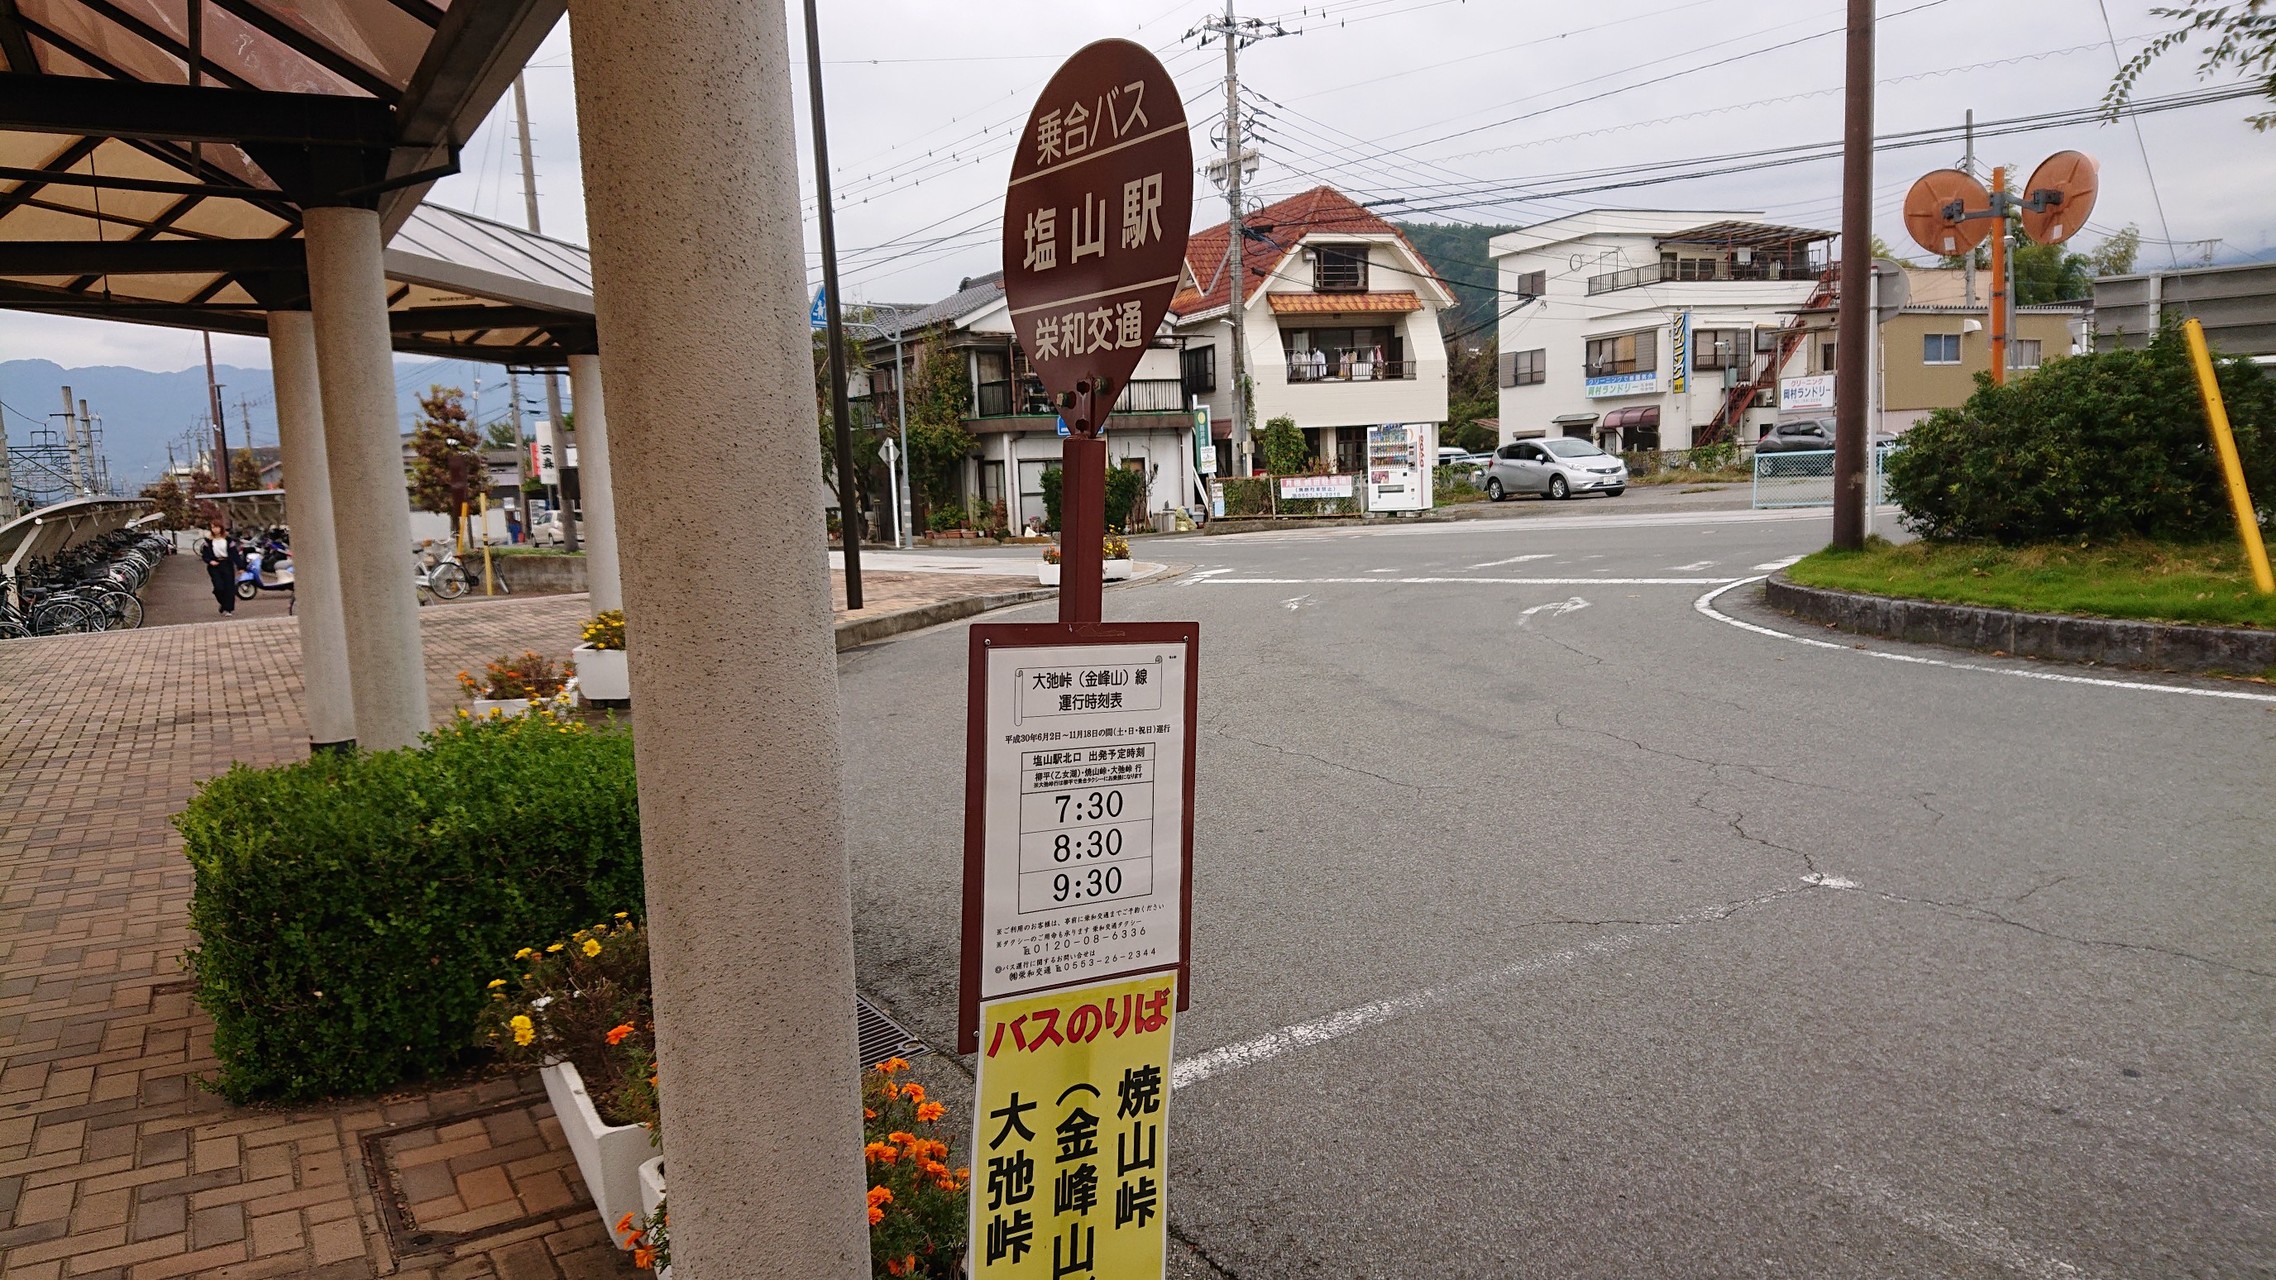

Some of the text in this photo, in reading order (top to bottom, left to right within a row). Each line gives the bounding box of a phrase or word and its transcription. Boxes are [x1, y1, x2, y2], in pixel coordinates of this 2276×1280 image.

[1037, 80, 1149, 166] 乗合バス
[1023, 172, 1163, 272] 塩山駅
[1035, 300, 1143, 361] 栄和交通
[1784, 385, 1831, 400] 岡村ランドリー
[1058, 692, 1123, 711] 運行時刻表
[1033, 747, 1145, 767] 塩山駅北口 出発予定時刻
[1055, 790, 1123, 823] 7:30
[1053, 828, 1123, 862] 8:30
[1053, 867, 1122, 902] 9:30
[987, 987, 1171, 1058] バスのりば
[1115, 1064, 1161, 1230] 焼山峠
[986, 1091, 1038, 1267] 大弛峠
[1053, 1083, 1101, 1280] （金峰山
